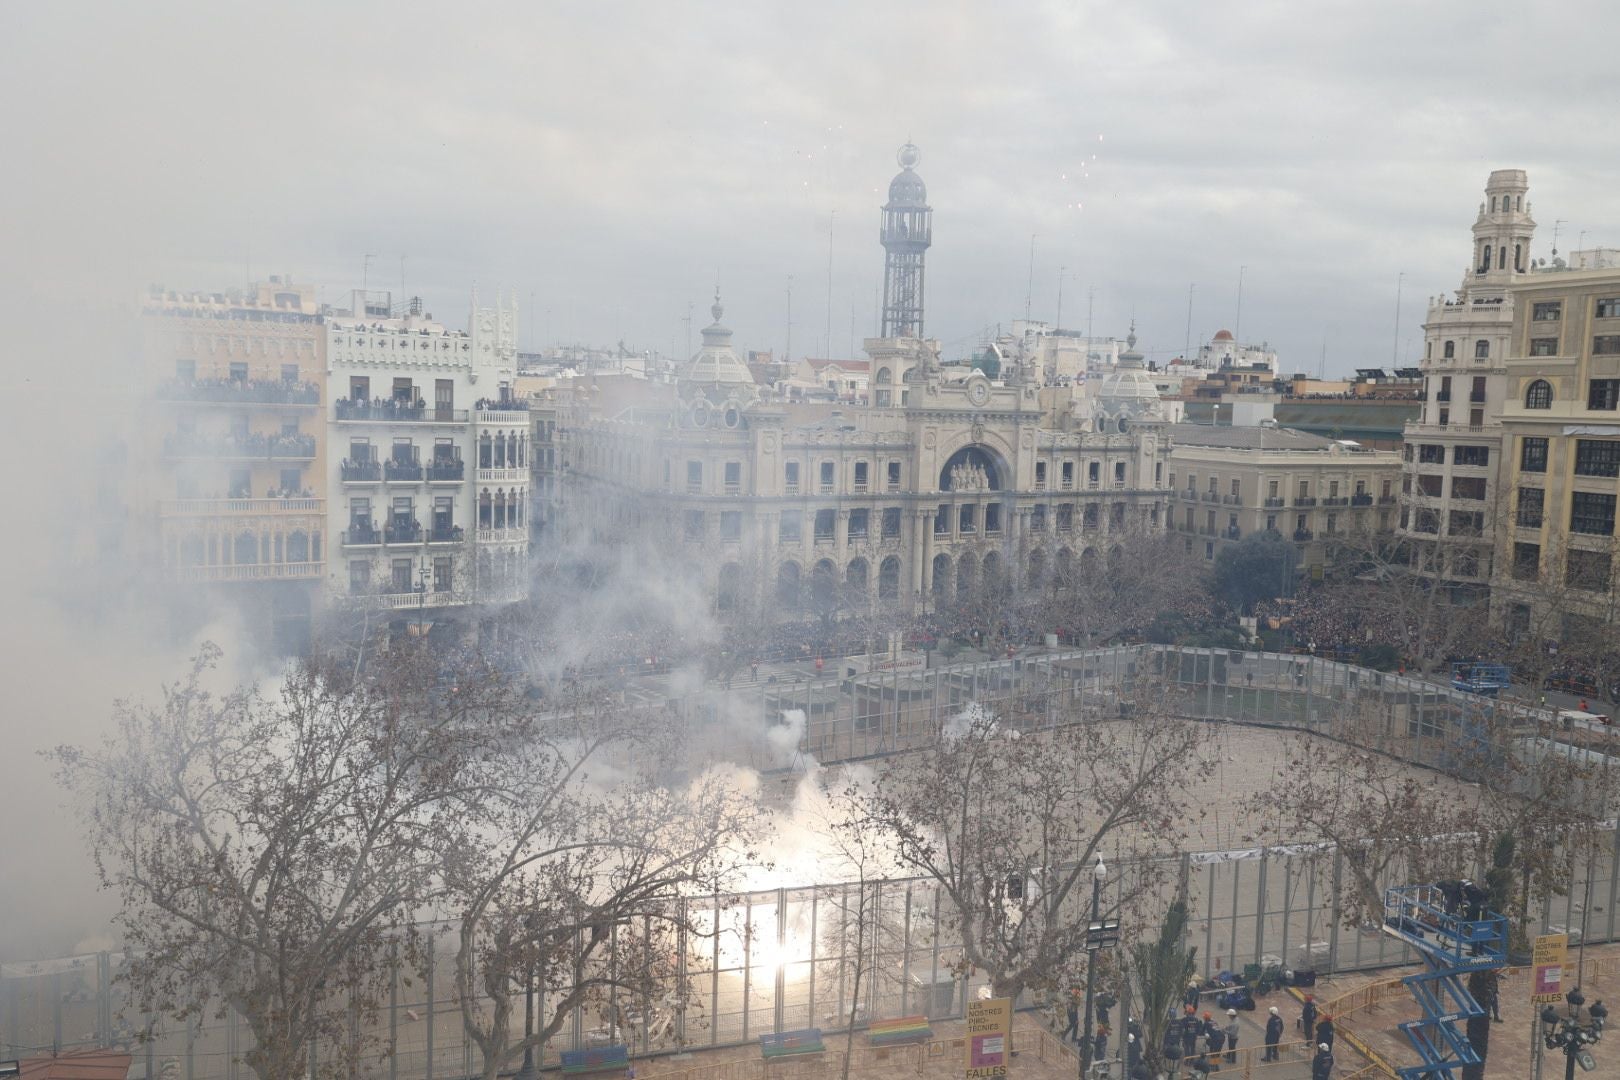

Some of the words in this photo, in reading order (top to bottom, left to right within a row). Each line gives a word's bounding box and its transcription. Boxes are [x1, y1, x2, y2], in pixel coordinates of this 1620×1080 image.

[1531, 993, 1562, 1005] FALLES
[969, 1002, 982, 1010] LES
[968, 1008, 1002, 1017] NOSTRES
[966, 1066, 1006, 1079] FALLES
